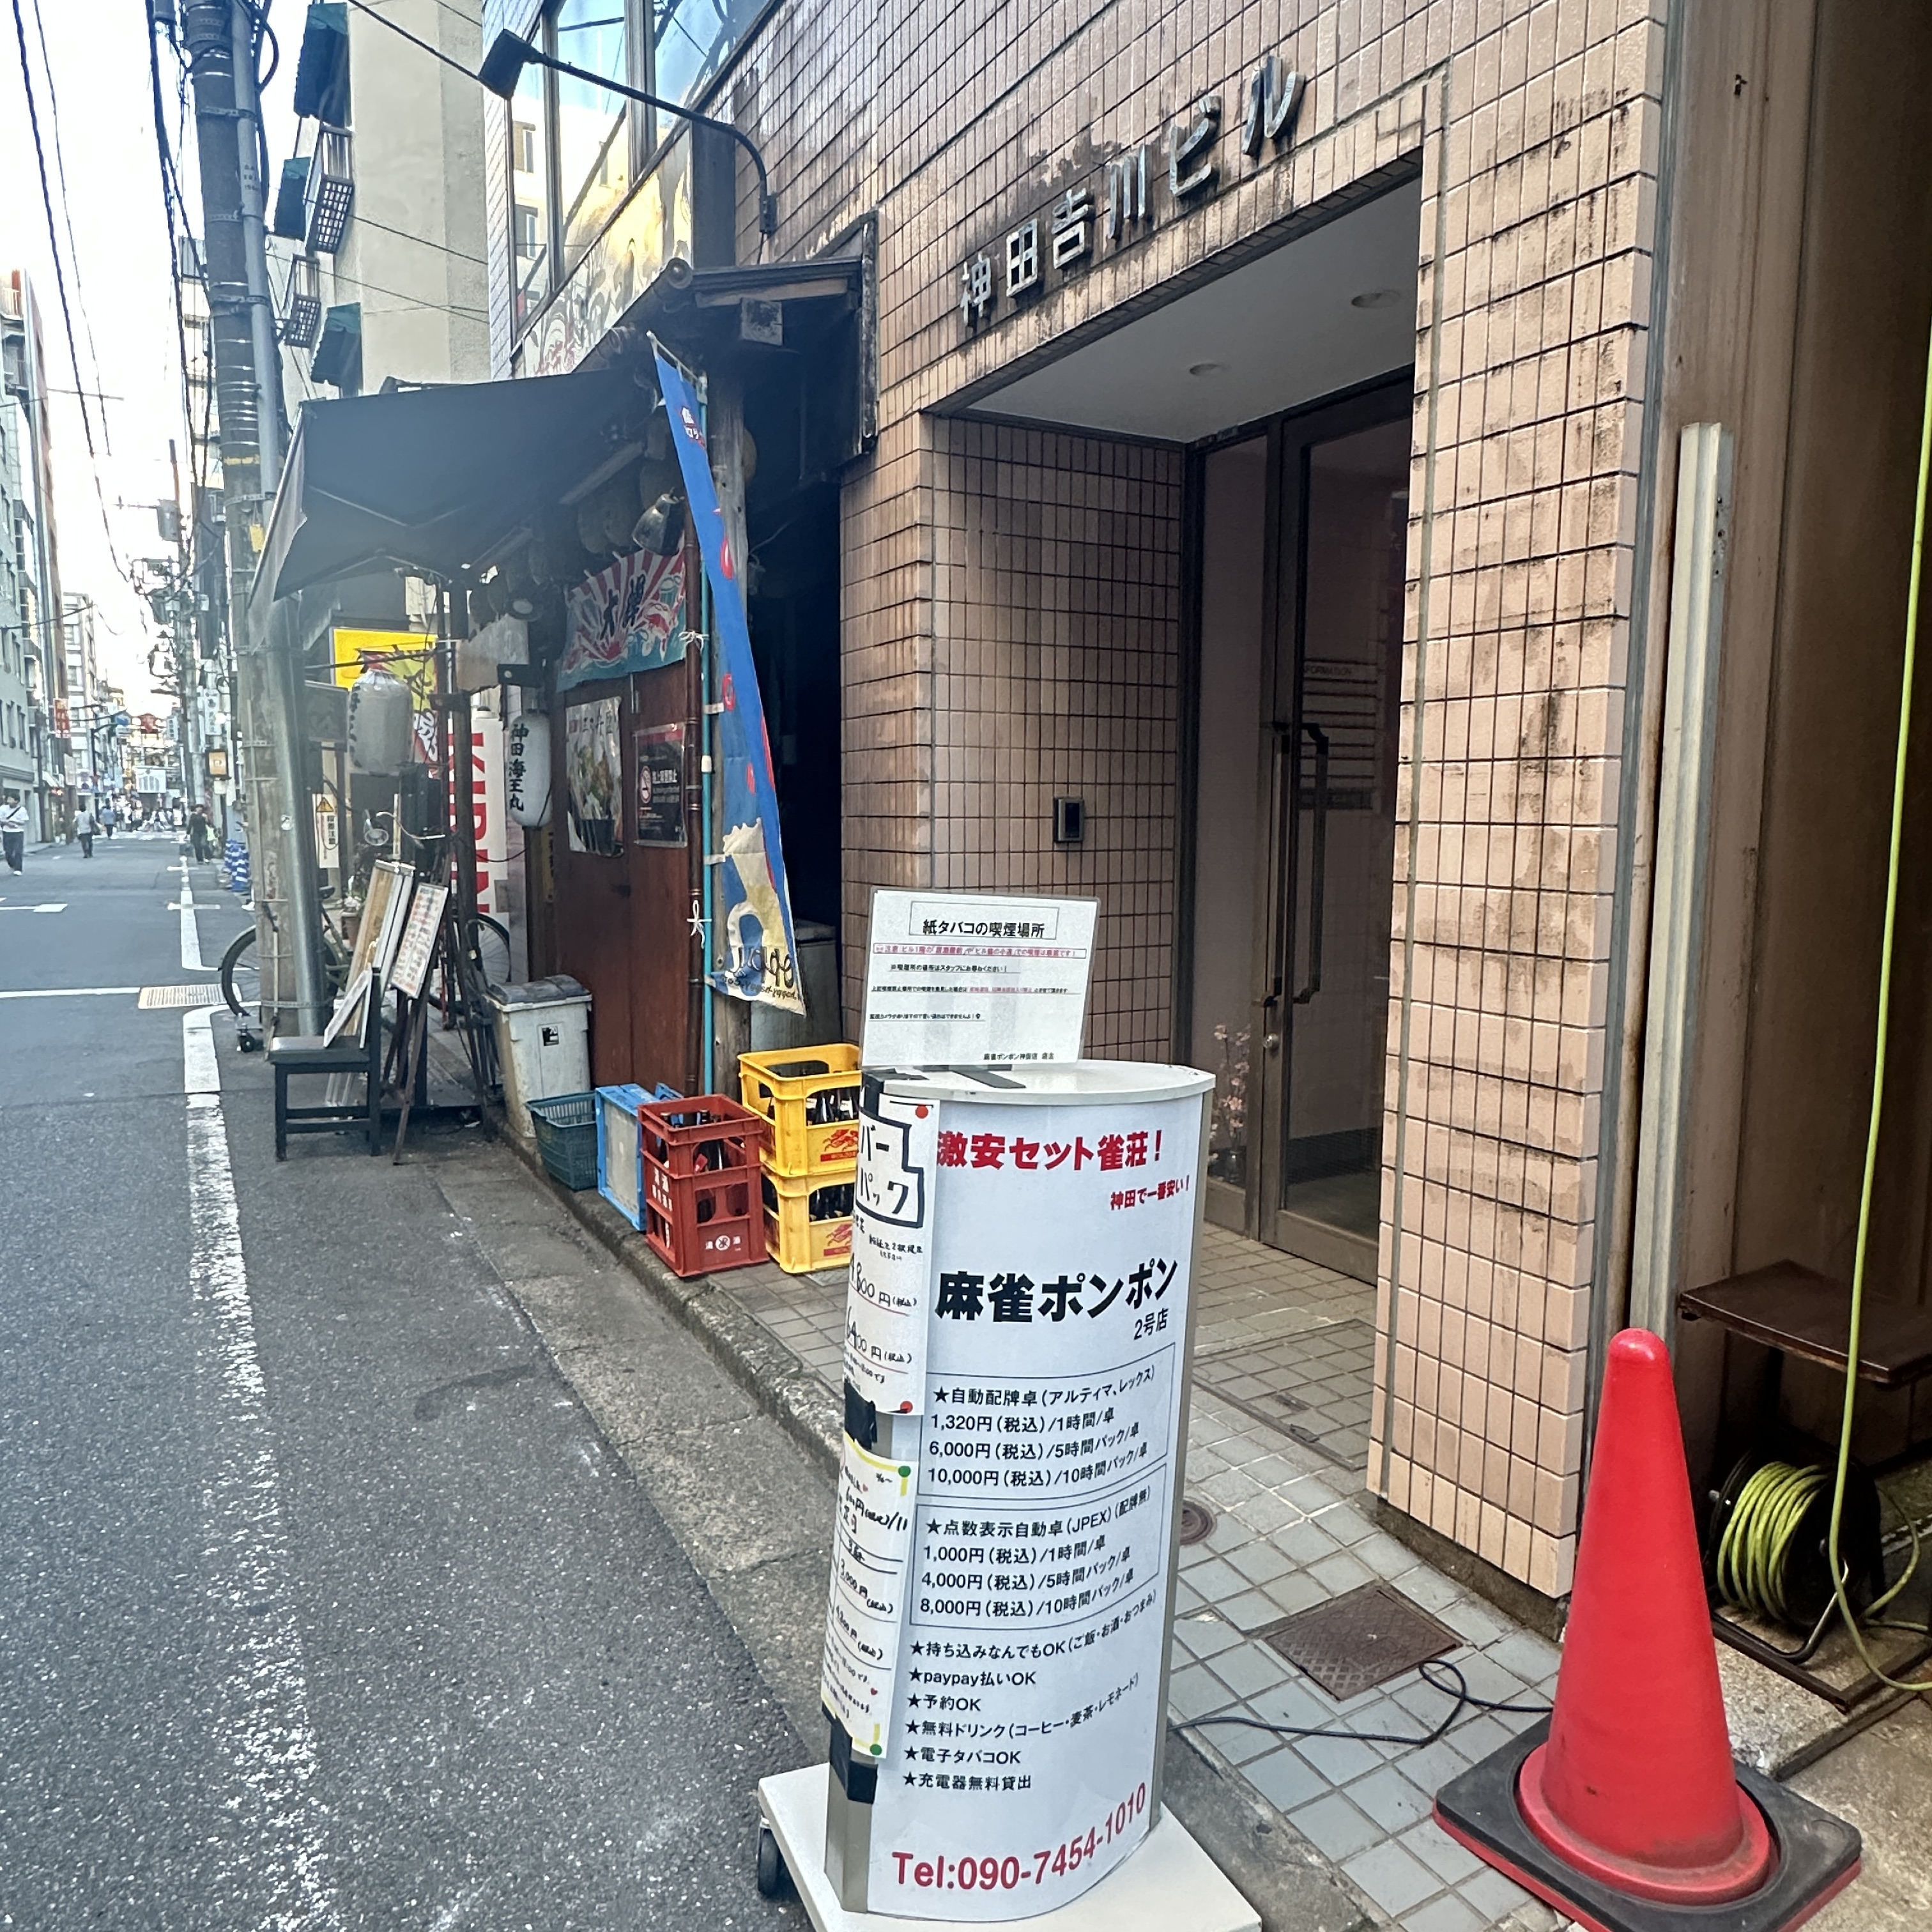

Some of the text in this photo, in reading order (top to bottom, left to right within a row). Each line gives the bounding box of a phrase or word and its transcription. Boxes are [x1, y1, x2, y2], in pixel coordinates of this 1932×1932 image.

[960, 56, 1306, 325] 神田吉川ビル
[923, 919, 1045, 939] 紙タバコの喫煙場所
[937, 1130, 1163, 1171] 激安セット雀荘!
[1110, 1175, 1190, 1211] 神田で一番安い!
[935, 1257, 1178, 1322] 麻雀ポンポン
[1133, 1307, 1169, 1340] 2号店
[924, 1671, 1036, 1687] paypay払いOK
[923, 1695, 982, 1712] 予約OK
[920, 1747, 1021, 1765] 電子タバコOK
[918, 1773, 1032, 1791] 充電器無料貸出
[892, 1782, 1146, 1890] Tel:090-7454-1010
